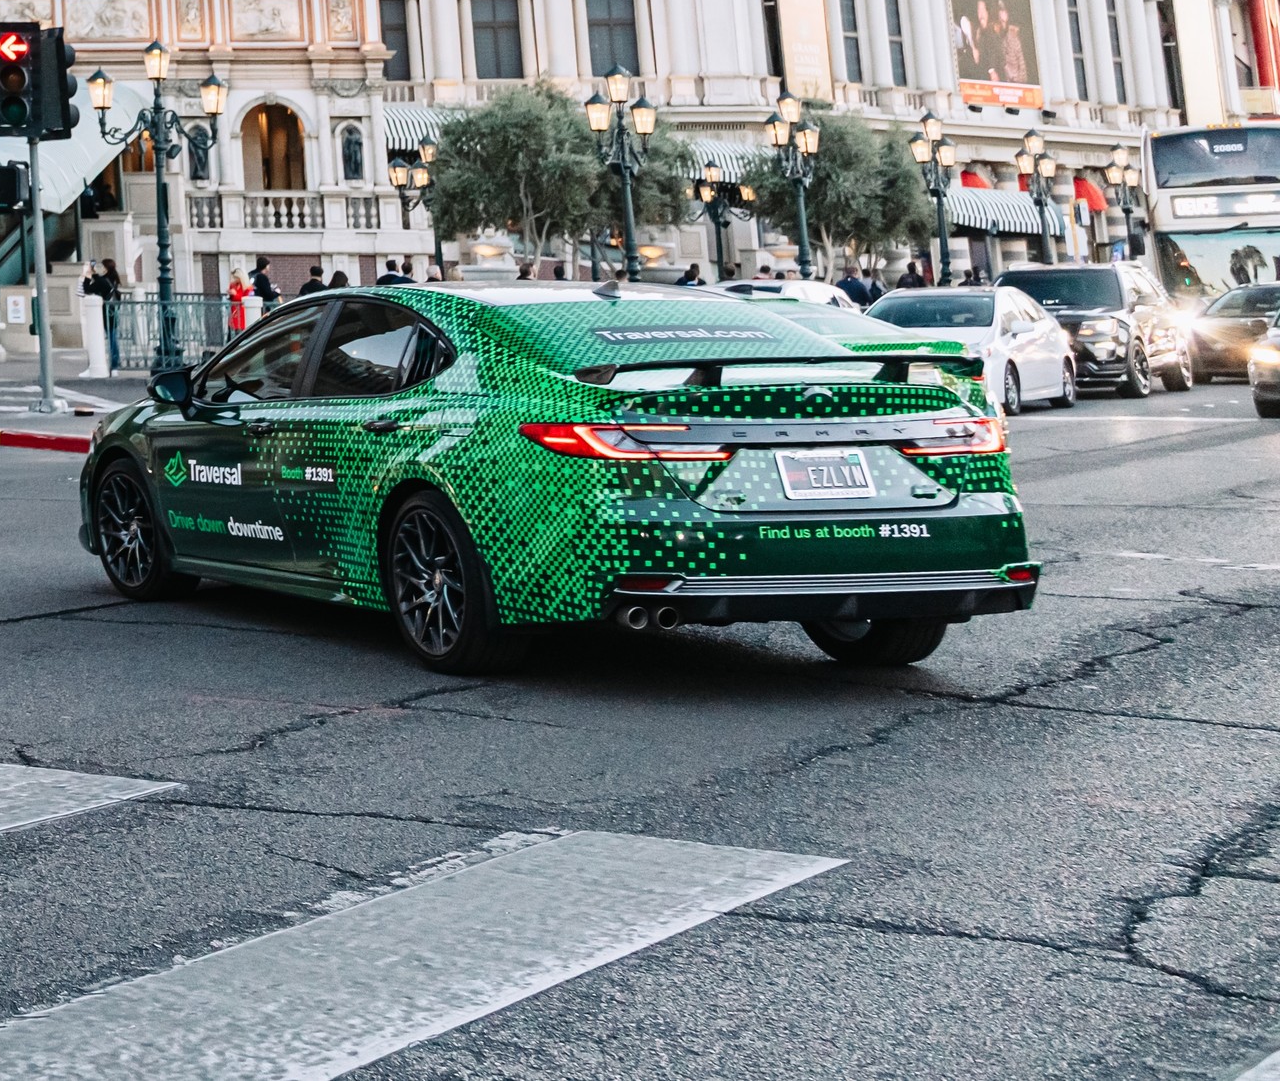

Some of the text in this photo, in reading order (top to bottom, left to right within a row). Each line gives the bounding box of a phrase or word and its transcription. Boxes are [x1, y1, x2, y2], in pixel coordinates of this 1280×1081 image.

[595, 328, 775, 341] Traversal.com
[188, 459, 242, 485] Traversal
[281, 465, 334, 482] Booth #1391
[807, 465, 867, 488] EZLYN
[168, 510, 284, 541] Drive down downtime
[759, 524, 930, 539] Find us at booth #1391
